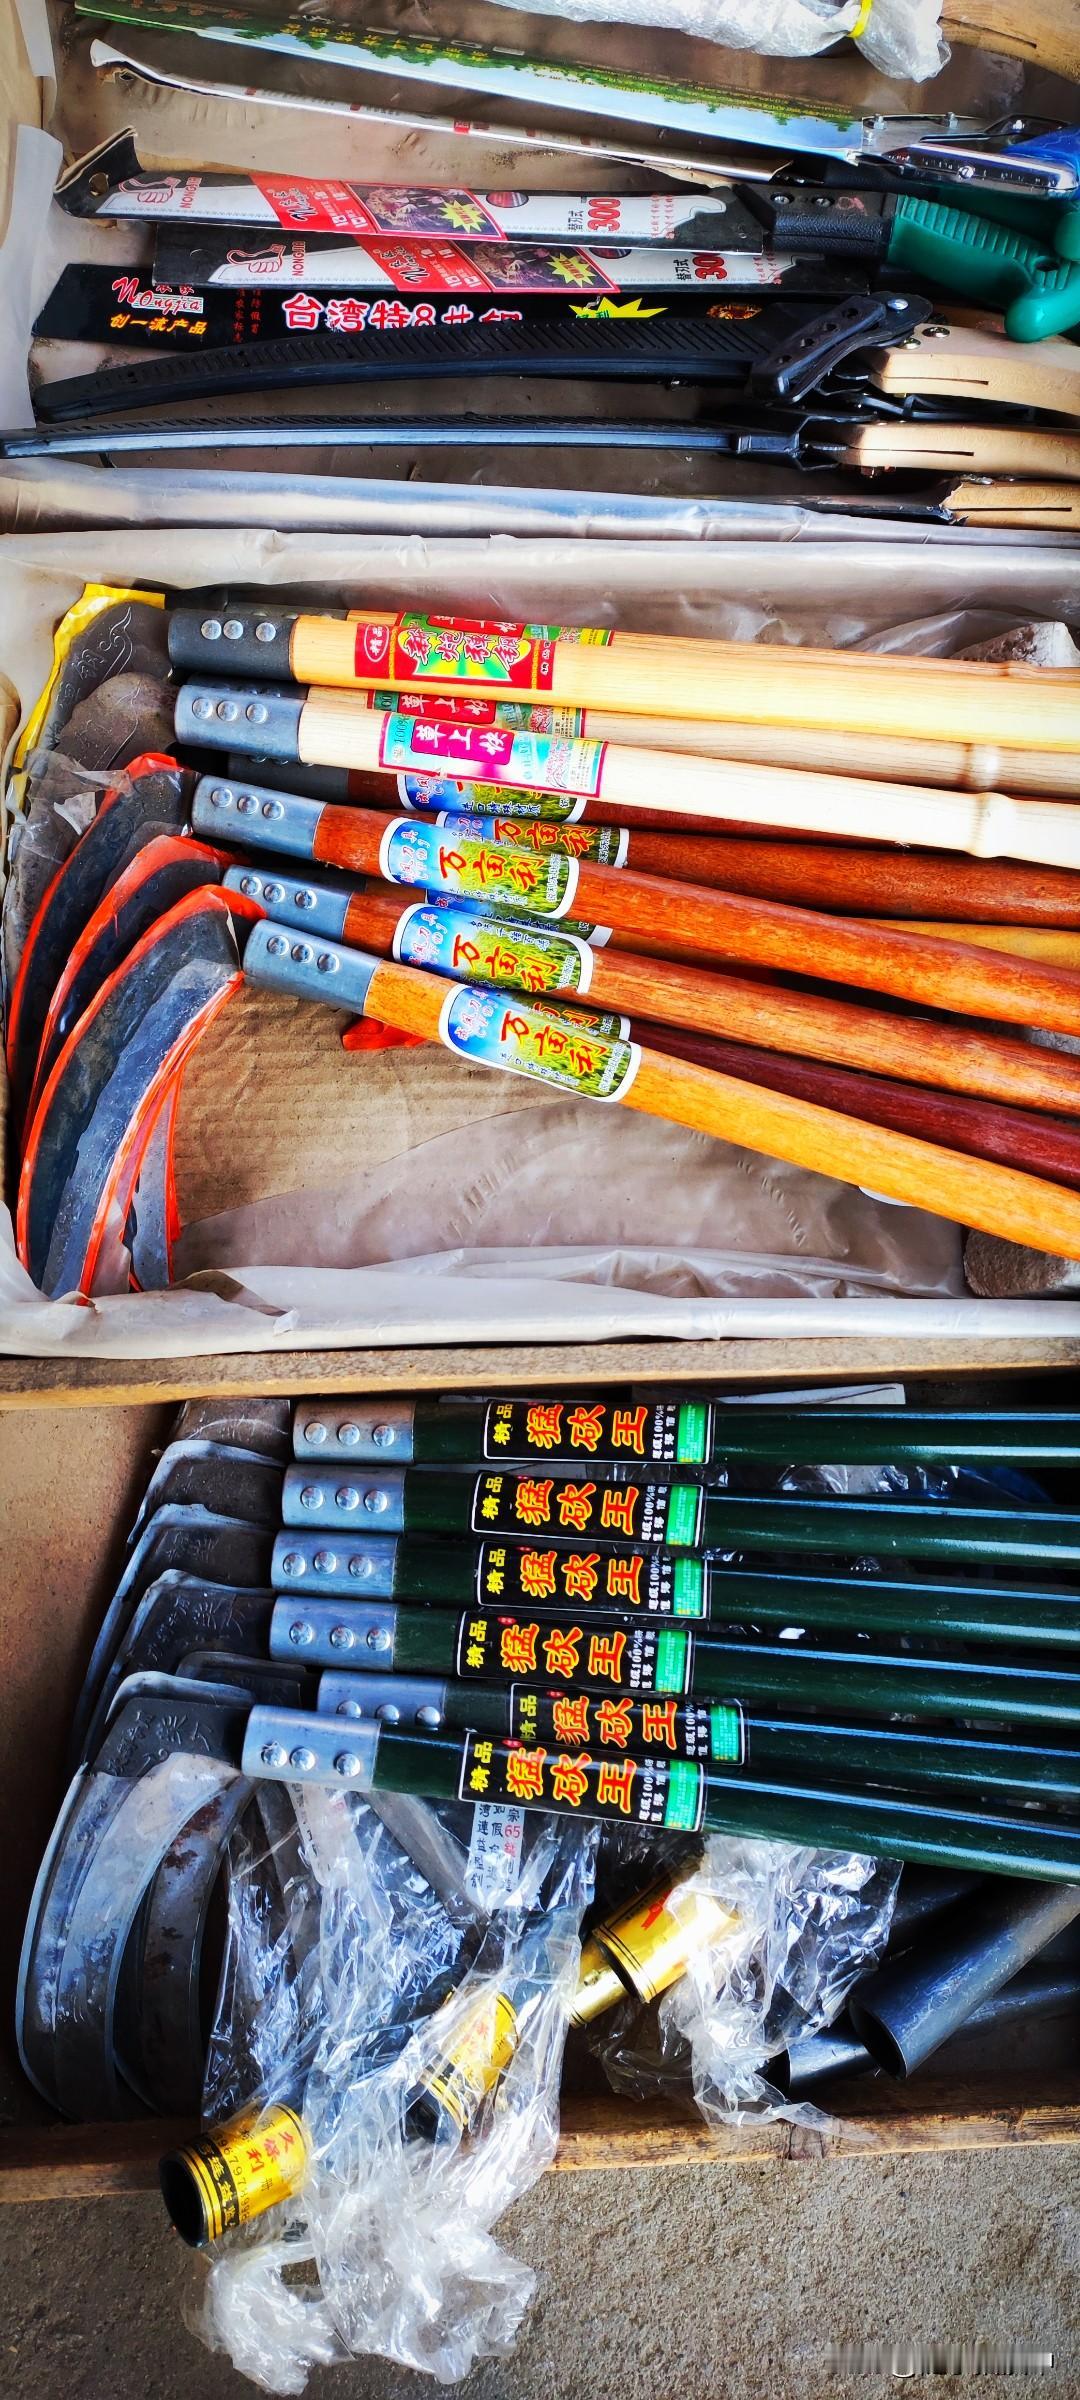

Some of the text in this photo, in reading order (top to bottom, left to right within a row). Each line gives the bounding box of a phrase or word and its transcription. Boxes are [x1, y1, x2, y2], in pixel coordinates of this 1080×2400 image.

[587, 198, 621, 232] 300
[110, 313, 208, 336] 创一流产品
[415, 723, 508, 757] 草上快
[438, 844, 546, 892] 万亩利
[451, 932, 559, 993] 万亩利
[500, 1009, 610, 1076] 万亩利
[493, 1404, 514, 1446] 精品
[526, 1402, 649, 1455] 猛砍王
[480, 1475, 504, 1520] 精品
[514, 1479, 640, 1537] 猛砍王
[485, 1548, 507, 1596] 精品
[520, 1550, 644, 1606] 猛砍王
[465, 1618, 489, 1669] 精品
[499, 1622, 627, 1684] 猛砍王
[552, 1694, 678, 1751] 猛砍王
[469, 1740, 494, 1793] 精品
[506, 1745, 638, 1815] 猛砍王
